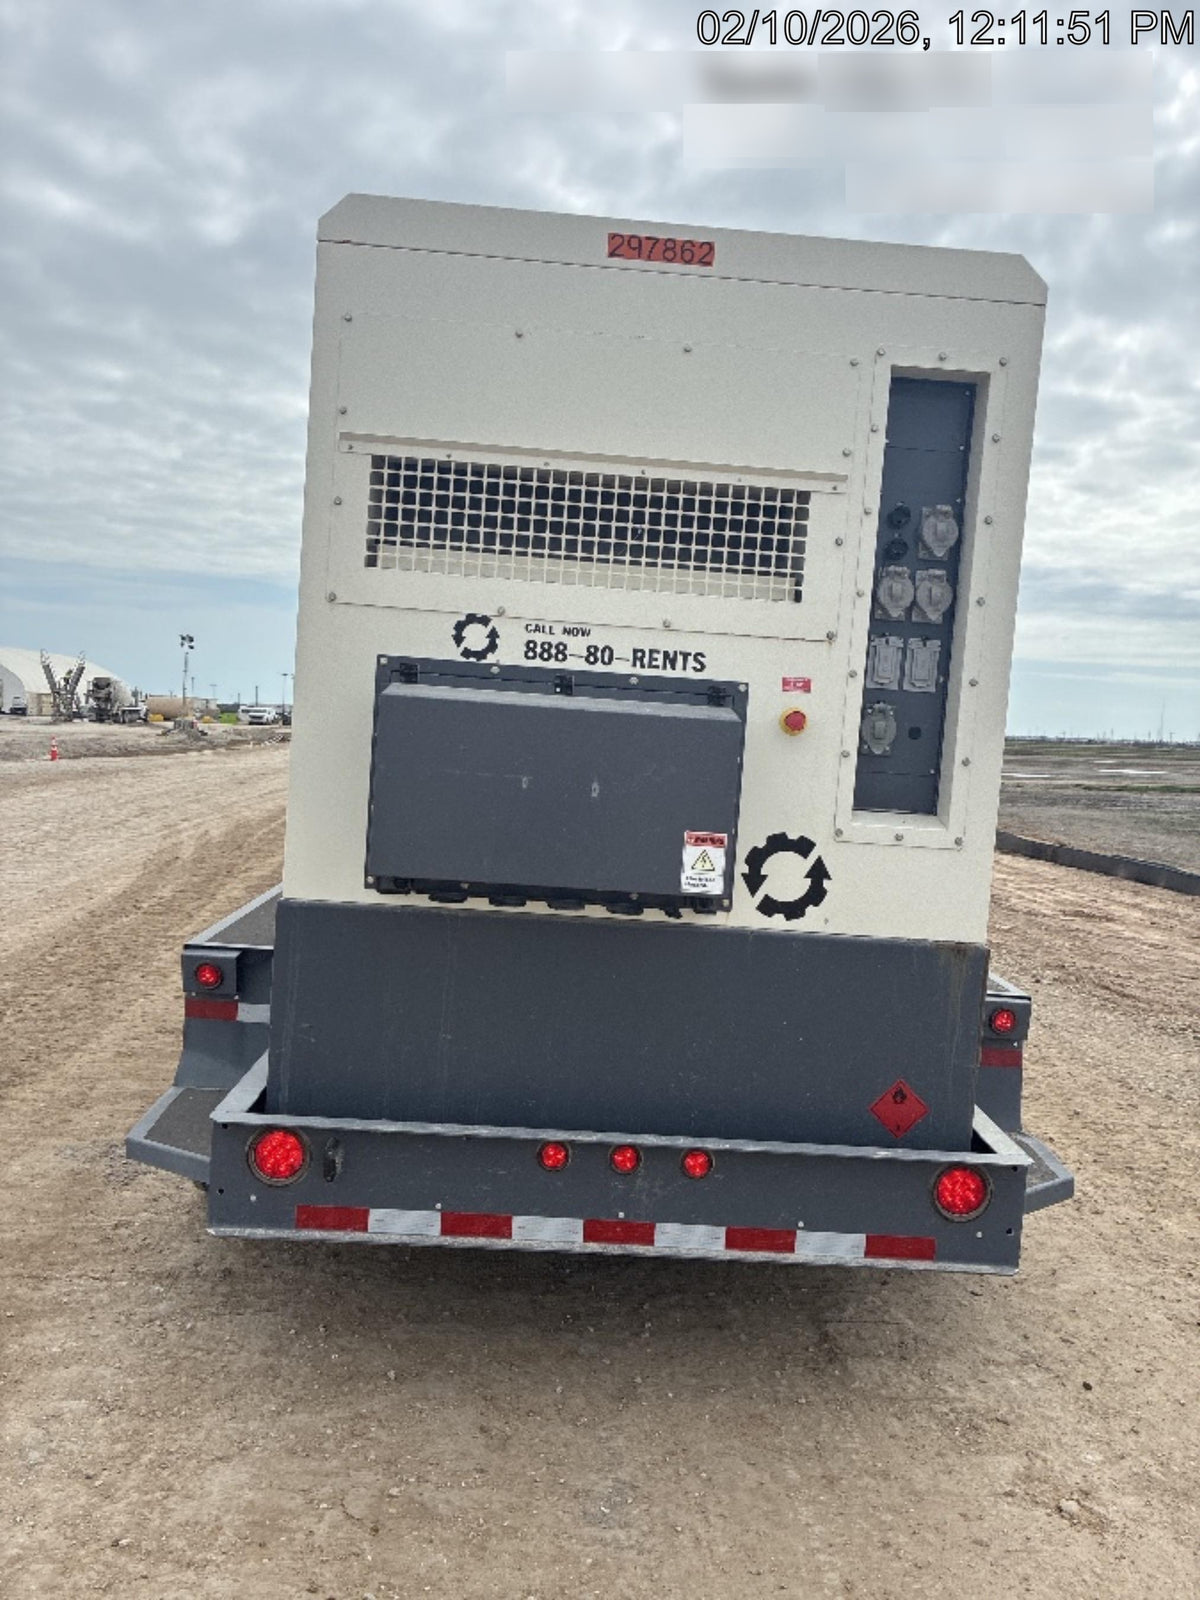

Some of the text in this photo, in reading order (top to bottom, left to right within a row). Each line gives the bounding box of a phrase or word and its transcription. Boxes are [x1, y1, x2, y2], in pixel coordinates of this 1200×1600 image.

[609, 234, 714, 265] 297862
[525, 623, 591, 638] CALL NOW
[524, 640, 707, 673] 888-80-RENTS
